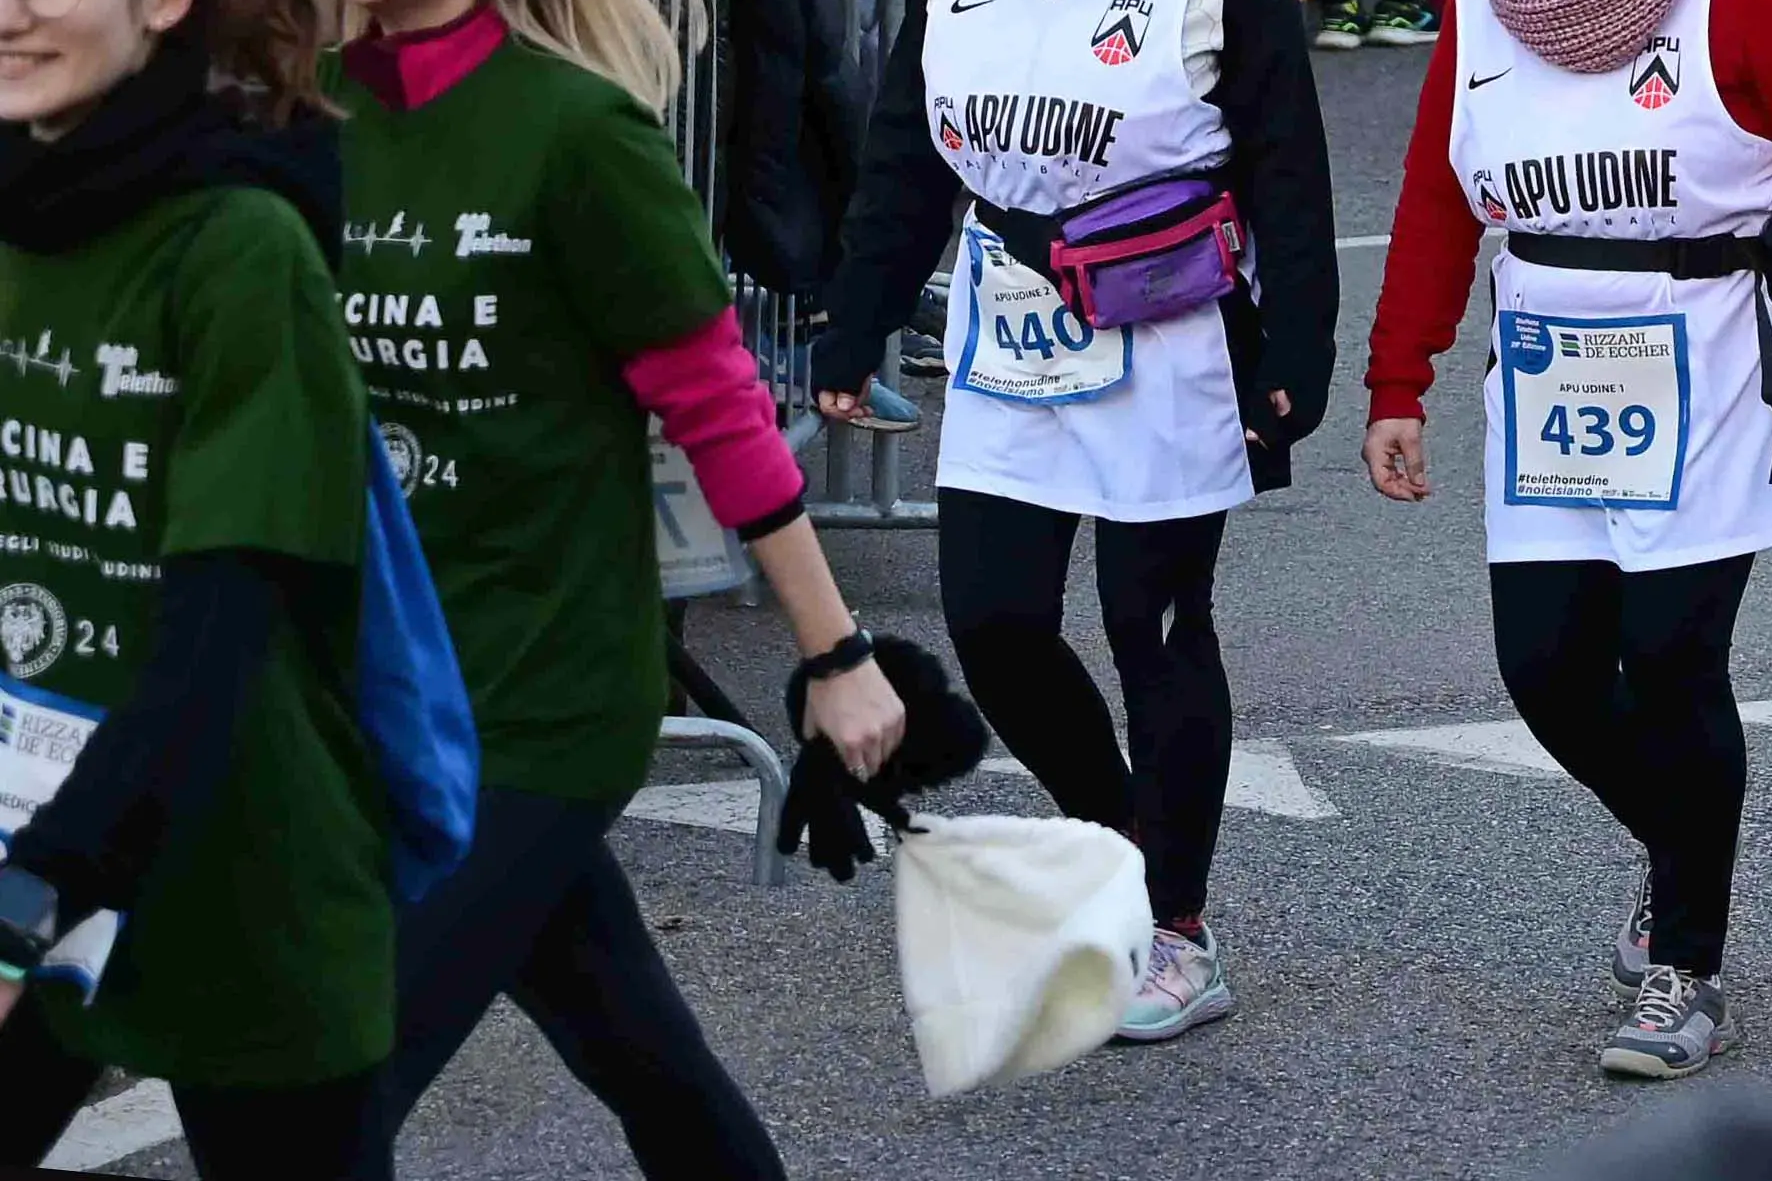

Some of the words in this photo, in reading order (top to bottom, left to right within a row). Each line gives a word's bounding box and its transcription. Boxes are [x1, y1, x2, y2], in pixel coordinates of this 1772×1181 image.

[1645, 35, 1681, 55] APU
[934, 96, 953, 109] APU
[965, 94, 1020, 153] APU
[1020, 95, 1125, 168] UDINE
[1473, 169, 1493, 185] APU
[1505, 155, 1571, 220] APU
[1574, 149, 1678, 213] UDINE
[455, 211, 533, 257] Telethon
[995, 292, 1012, 303] APU
[1014, 290, 1042, 302] UDINE
[1044, 286, 1051, 296] 2
[335, 293, 443, 327] CINA
[473, 294, 498, 326] E
[994, 303, 1095, 361] 440
[1584, 332, 1646, 346] RIZZANI
[1585, 346, 1605, 359] DE
[1609, 344, 1671, 359] ECCHER
[969, 369, 1061, 388] #telethonudine
[1559, 383, 1580, 393] APU
[1582, 383, 1617, 394] UDINE
[1619, 383, 1625, 393] 1
[457, 393, 519, 412] UDINE
[1540, 404, 1656, 457] 439
[122, 442, 149, 480] E
[423, 454, 460, 488] 24
[1518, 473, 1609, 486] #telethonudine
[1517, 484, 1593, 497] #noicisiamo
[74, 619, 121, 658] 24
[17, 731, 39, 756] DE
